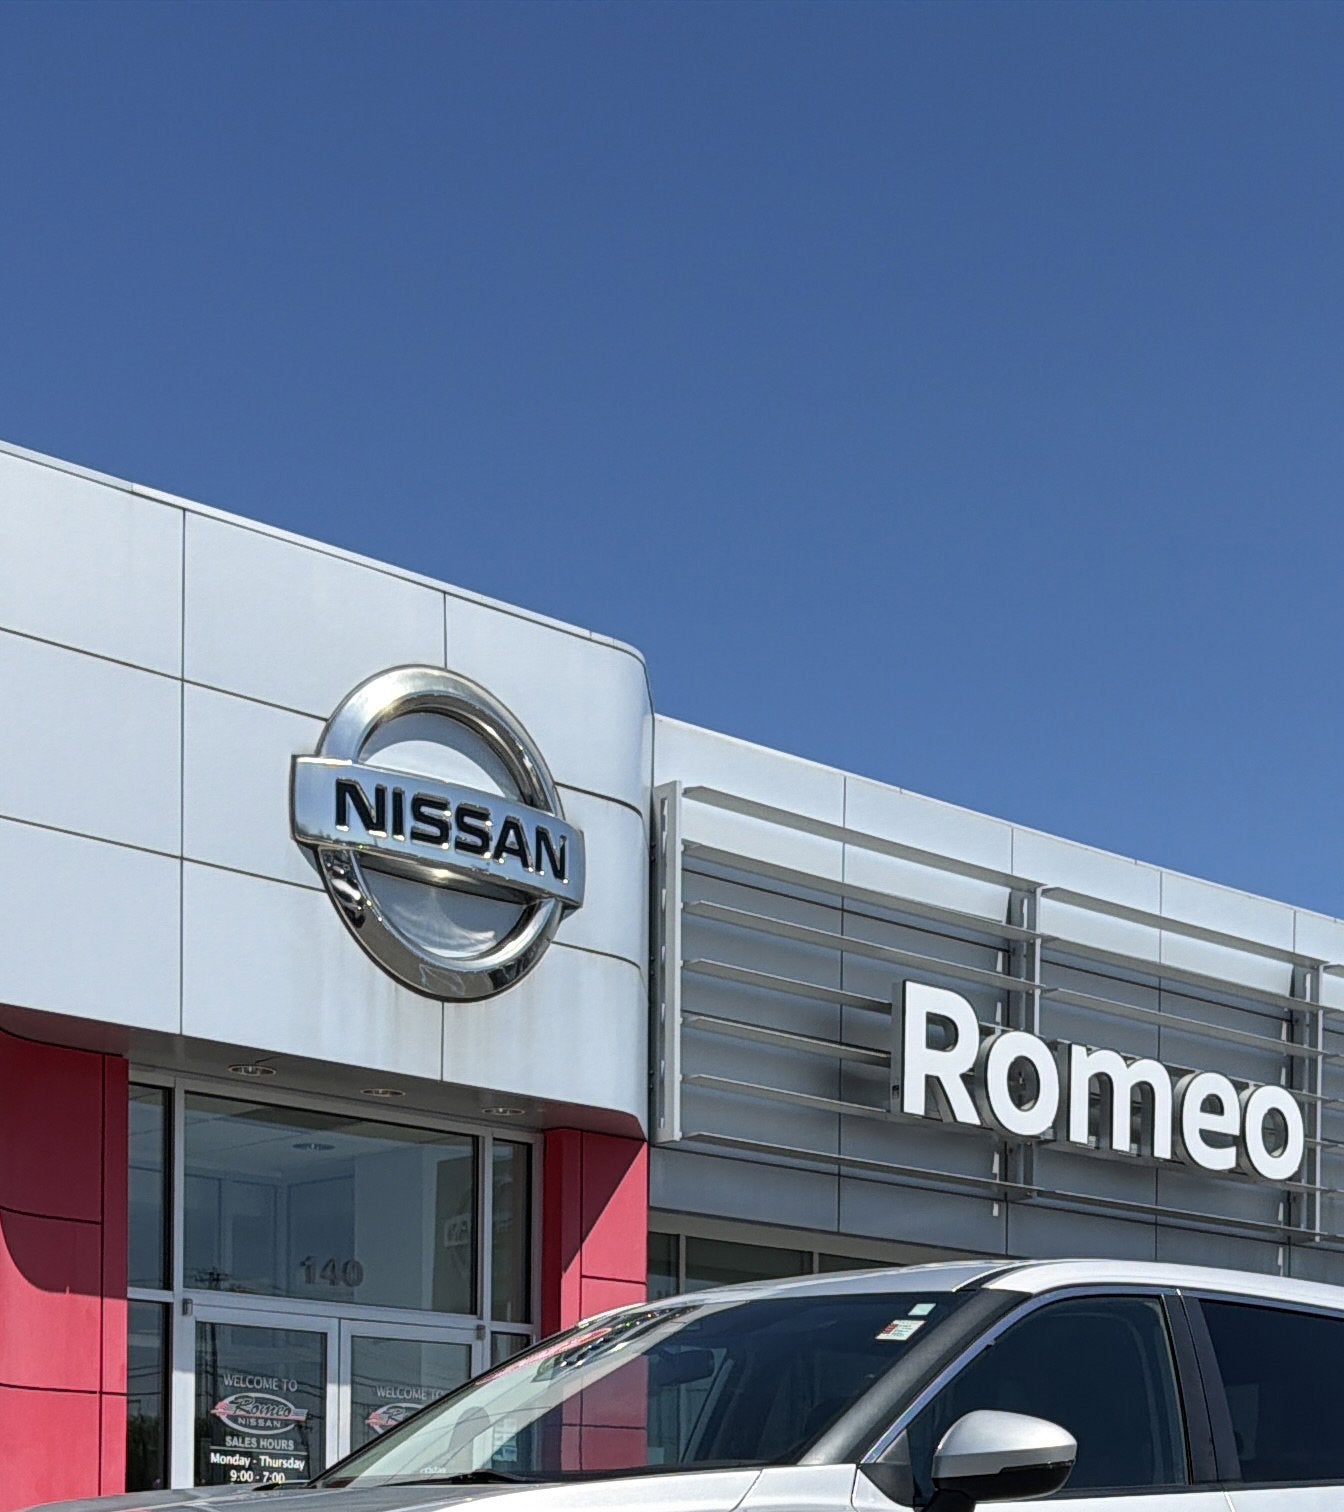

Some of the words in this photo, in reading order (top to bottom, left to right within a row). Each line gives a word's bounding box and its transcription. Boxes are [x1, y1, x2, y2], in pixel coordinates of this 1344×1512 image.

[334, 777, 568, 885] NISSAN
[902, 980, 1304, 1180] Romeo
[300, 1256, 364, 1288] 140
[223, 1373, 279, 1390] WELCOME
[282, 1378, 298, 1391] TO
[377, 1386, 427, 1400] WELCOME
[229, 1395, 292, 1417] Romeo
[237, 1417, 281, 1428] NISSAN
[225, 1435, 257, 1449] SALES
[259, 1438, 295, 1451] HOURS
[210, 1452, 251, 1469] Monday
[259, 1455, 306, 1471] Thursday
[230, 1469, 254, 1482] 9:00
